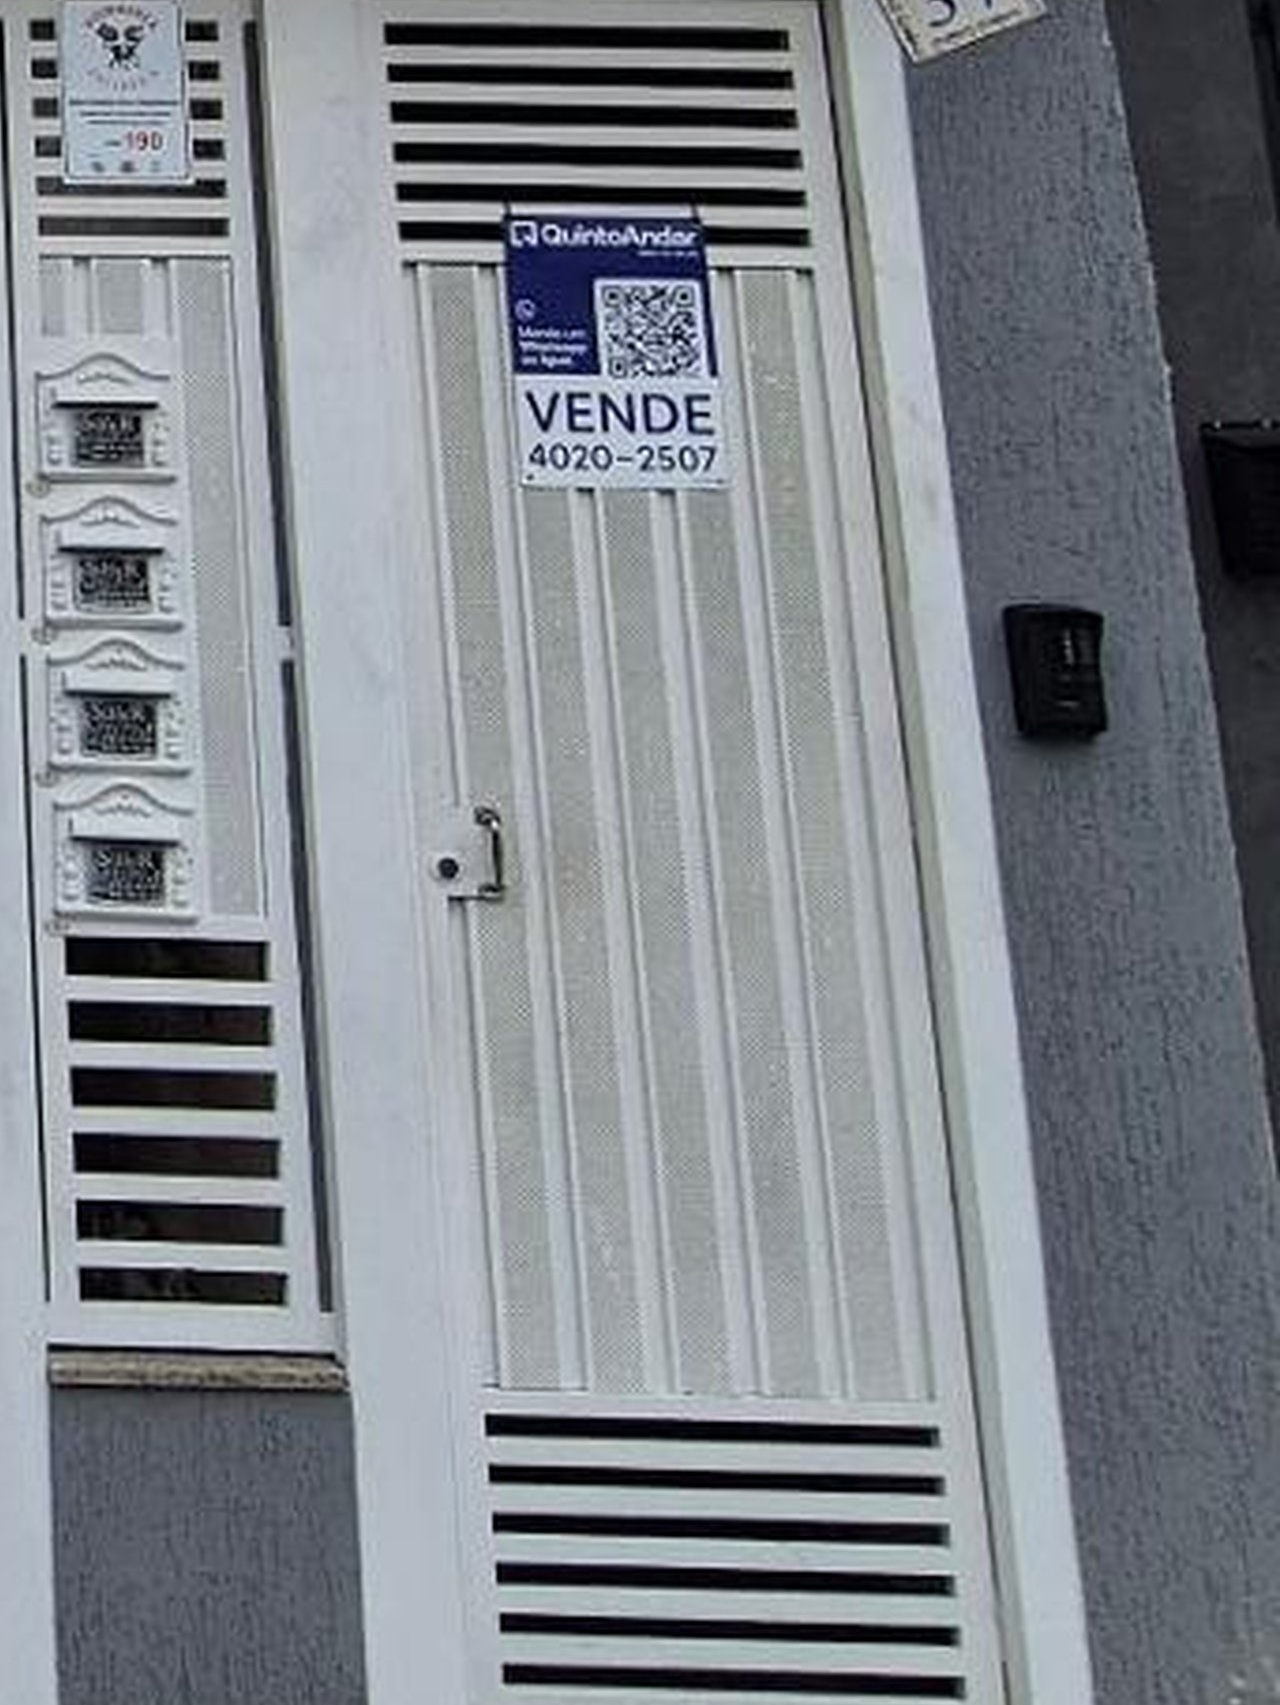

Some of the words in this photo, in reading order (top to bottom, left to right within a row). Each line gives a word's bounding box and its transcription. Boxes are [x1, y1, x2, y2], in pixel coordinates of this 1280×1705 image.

[540, 222, 698, 247] QuintoAndar
[525, 391, 716, 436] VENDE
[529, 442, 718, 472] 4020-2507
